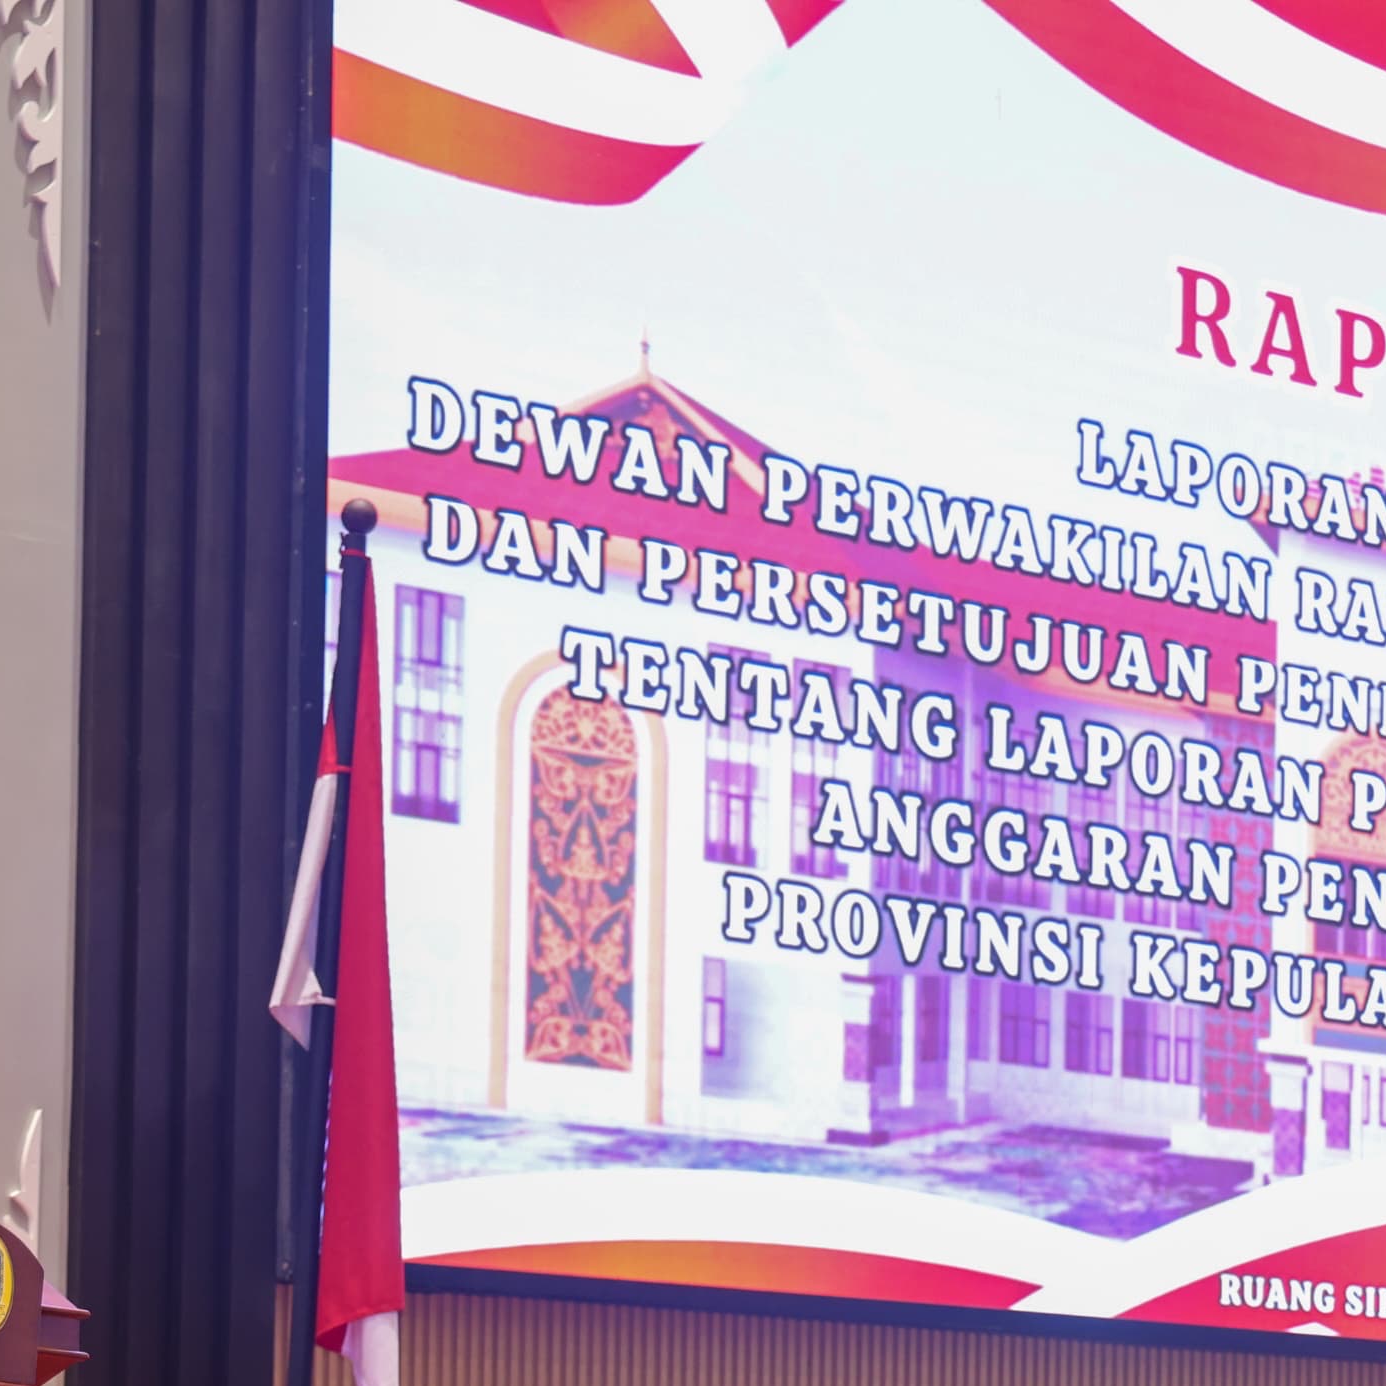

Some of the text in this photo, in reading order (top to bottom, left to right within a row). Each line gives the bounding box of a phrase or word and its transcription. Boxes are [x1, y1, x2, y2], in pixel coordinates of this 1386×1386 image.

[409, 376, 729, 512] DEWAN
[763, 453, 1271, 624] PERWAKILAN
[425, 495, 606, 592] DAN
[641, 537, 1210, 709] PERSETUJUAN
[562, 626, 957, 758] TENTANG
[986, 704, 1323, 821] LAPORAN
[812, 781, 1233, 910] ANGGARAN
[722, 872, 1101, 989] PROVINSI
[1220, 1272, 1337, 1315] RUANG
